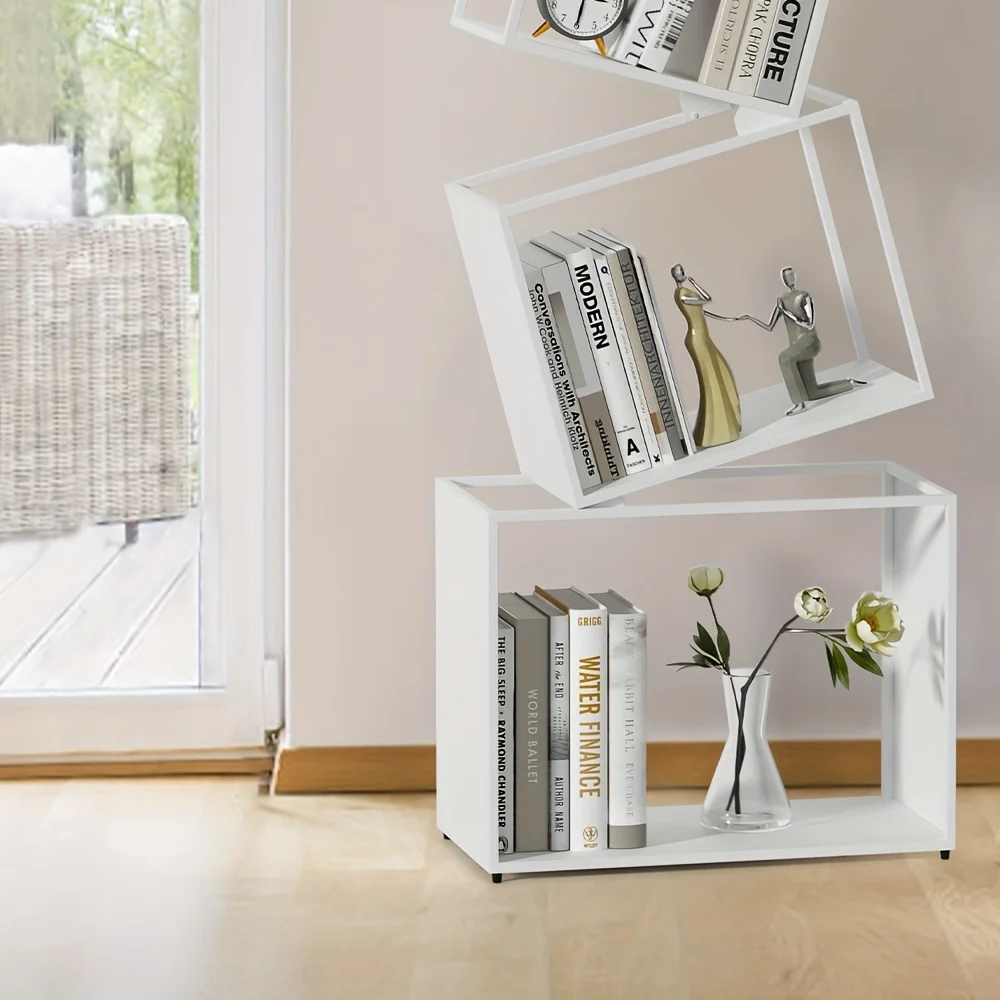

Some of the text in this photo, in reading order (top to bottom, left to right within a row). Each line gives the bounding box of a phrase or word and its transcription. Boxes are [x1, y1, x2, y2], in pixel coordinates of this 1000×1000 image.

[551, 0, 557, 10] 8
[561, 13, 567, 22] 7
[591, 20, 597, 30] 5
[603, 13, 609, 22] 4
[611, 0, 618, 9] 3
[739, 26, 764, 78] CHOPRA
[574, 264, 610, 350] MODERN
[620, 262, 676, 429] INNENARCHITEKTUR
[534, 283, 596, 477] Conversations with Architects
[547, 357, 559, 379] and
[554, 381, 572, 425] Heinrich
[567, 425, 580, 452] Klotz
[627, 438, 641, 456] A
[577, 616, 602, 626] GRIGG
[554, 642, 564, 699] AFTER the END
[625, 673, 635, 713] ABBIT
[498, 636, 506, 828] THE BIG SLEEP RAYMOND CHANDLER
[527, 688, 538, 784] WORLD BALLET
[579, 655, 601, 798] WATER FINANCE
[625, 719, 635, 753] HALL
[625, 762, 634, 781] EVE
[554, 776, 564, 833] AUTHOR NAME
